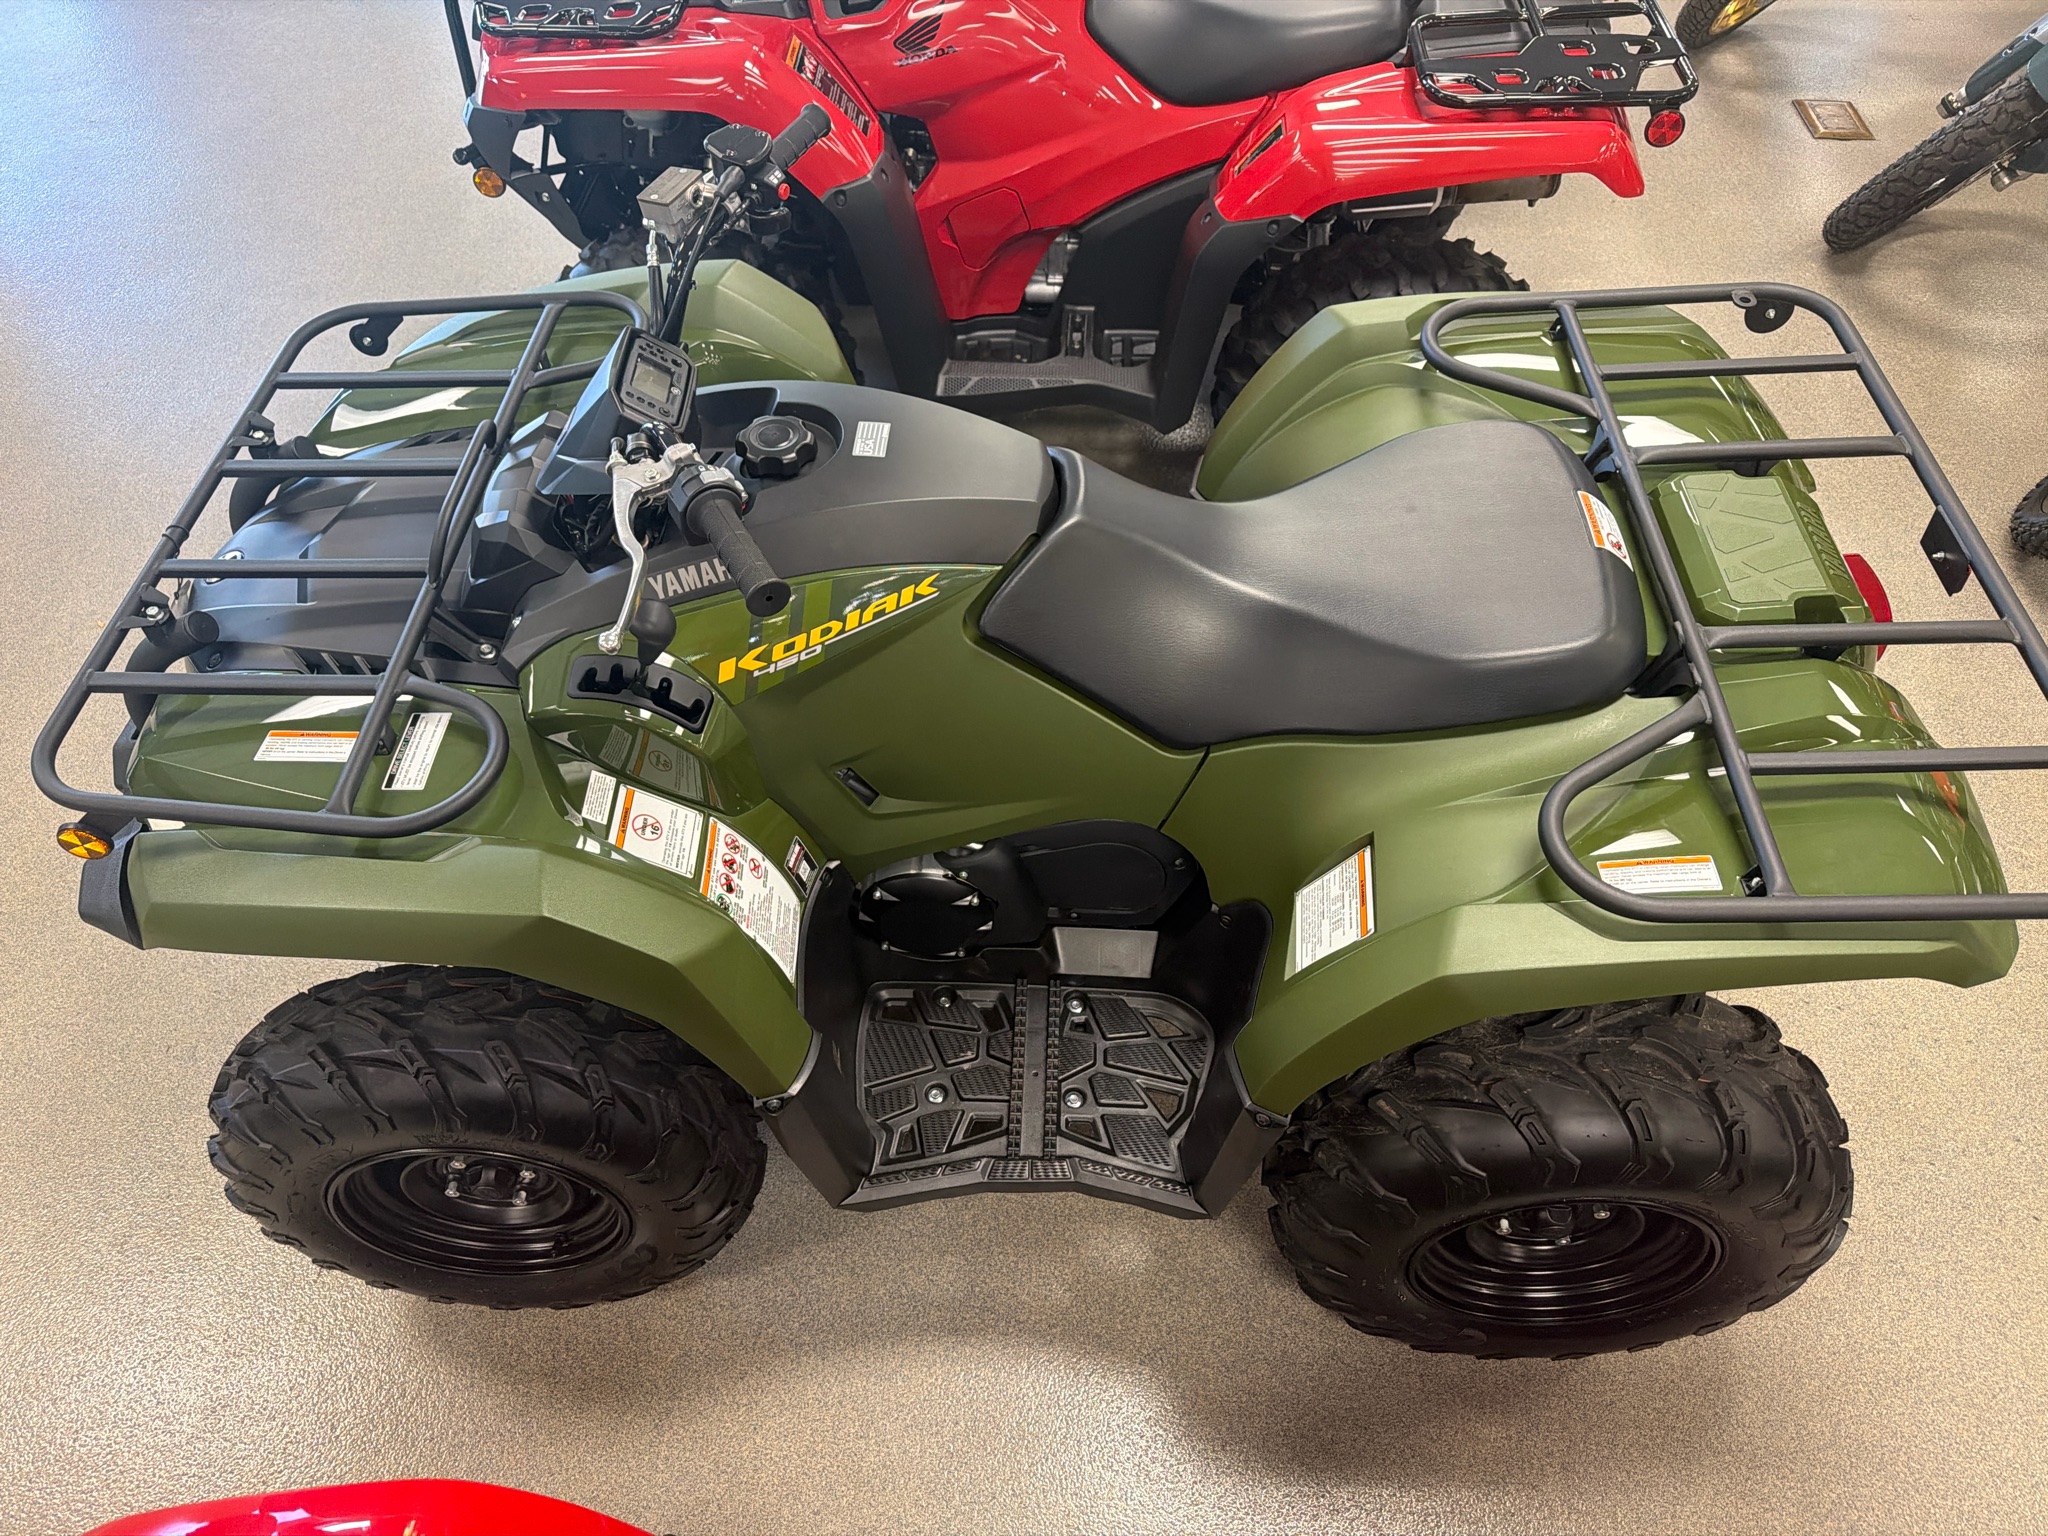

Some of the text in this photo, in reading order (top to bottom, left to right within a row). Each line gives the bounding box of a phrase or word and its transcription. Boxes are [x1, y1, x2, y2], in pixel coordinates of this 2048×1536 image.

[897, 44, 958, 67] HONDA
[647, 558, 732, 600] YAMAH
[717, 572, 941, 684] KODIAK
[752, 643, 823, 679] 450
[391, 726, 415, 775] DRIVE SELECT LEVER
[621, 807, 629, 830] WARNING
[650, 824, 660, 836] 16
